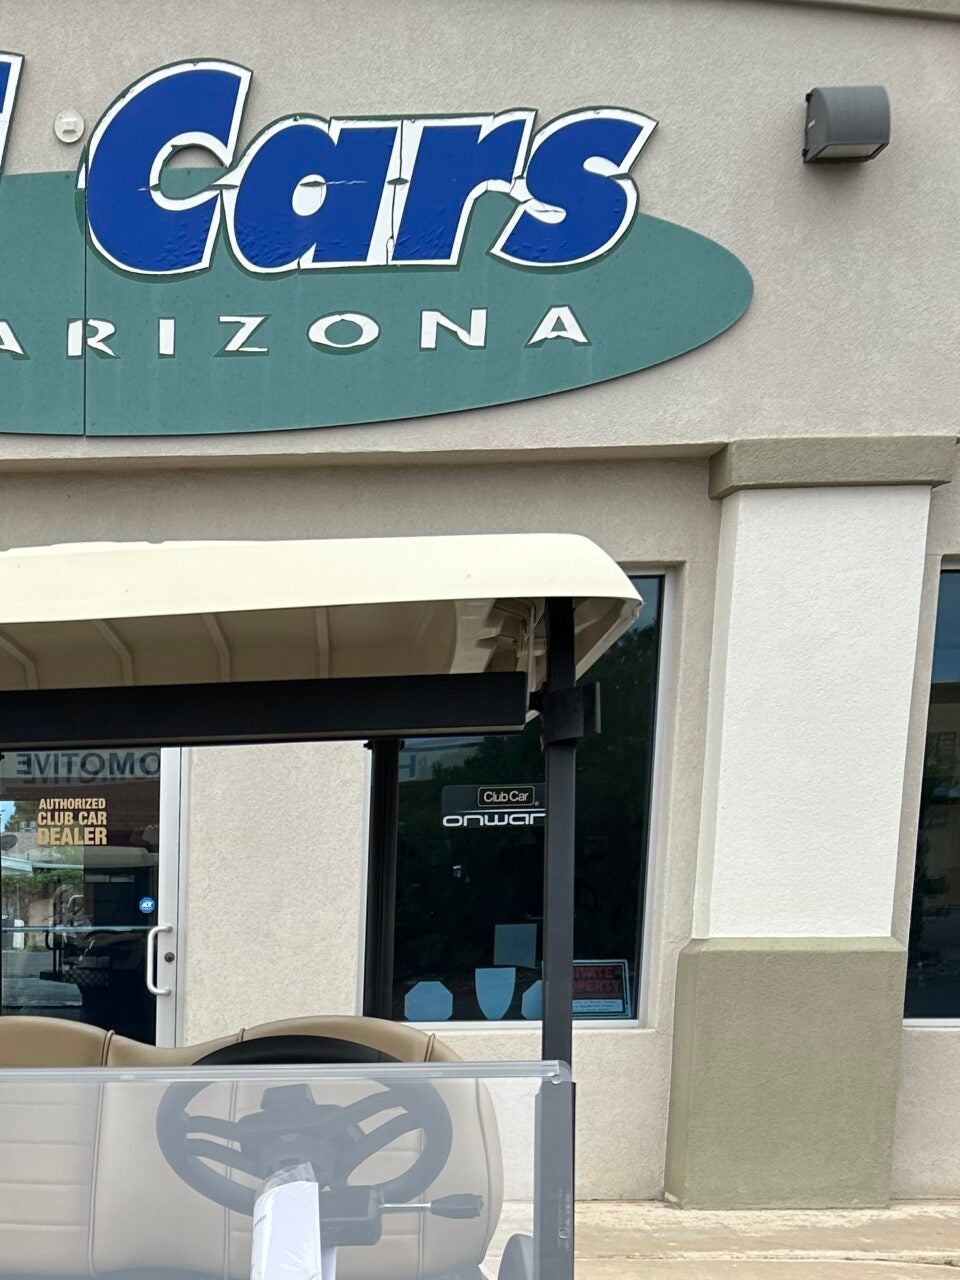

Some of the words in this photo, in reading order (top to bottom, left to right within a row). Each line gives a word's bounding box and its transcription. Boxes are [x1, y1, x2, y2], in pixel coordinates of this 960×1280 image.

[77, 58, 658, 278] Cars
[483, 791, 508, 802] Club
[509, 790, 529, 802] Car
[39, 798, 106, 810] AUTHORIZED
[37, 811, 74, 825] CLUB
[78, 811, 108, 825] CAR
[37, 827, 108, 845] DEALER
